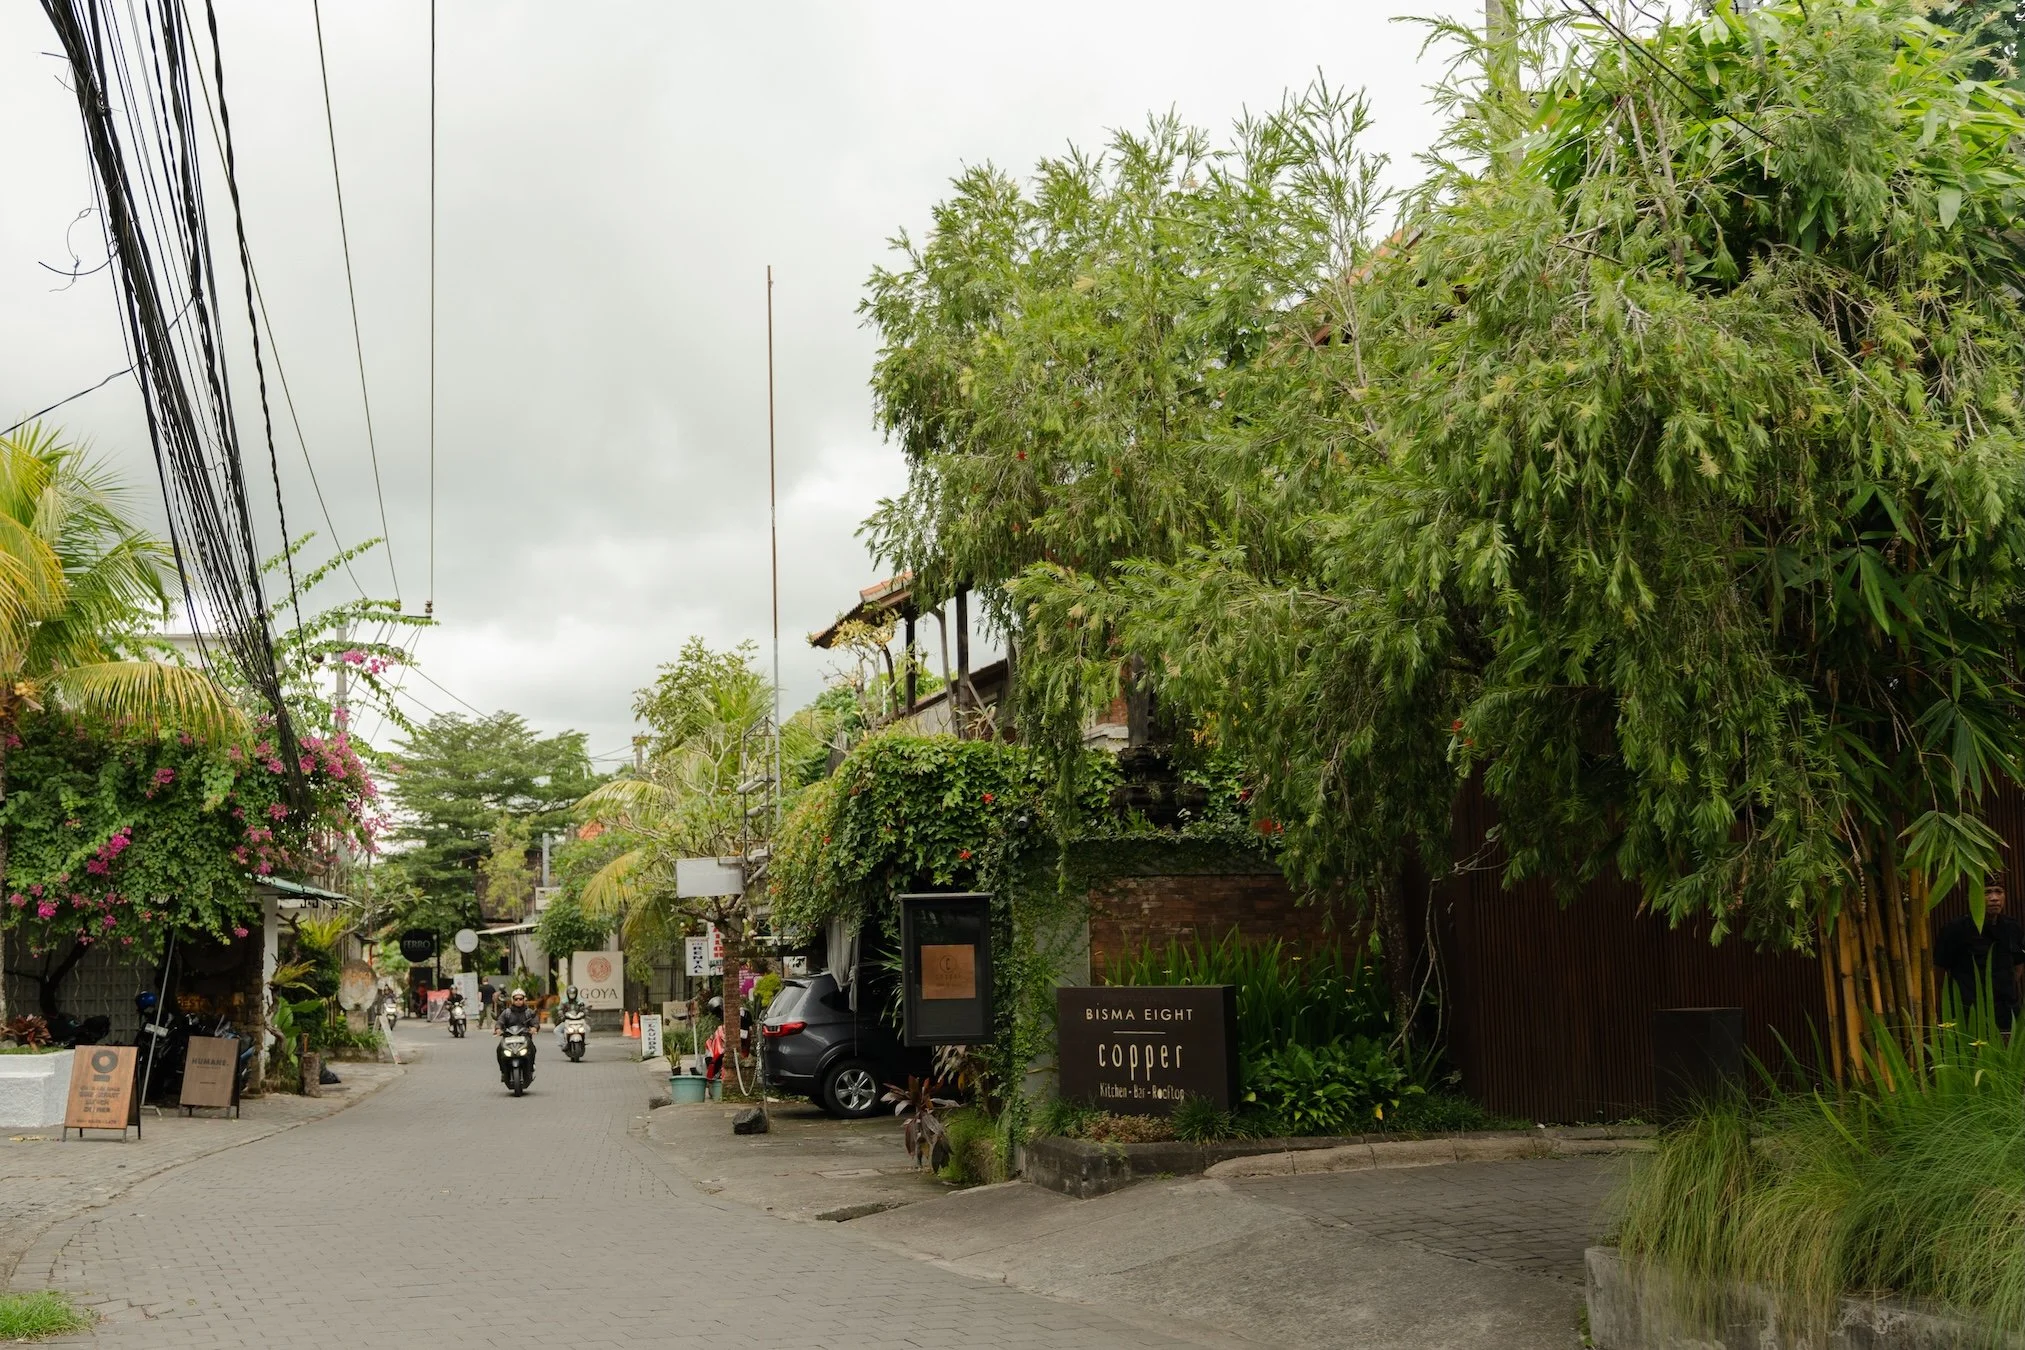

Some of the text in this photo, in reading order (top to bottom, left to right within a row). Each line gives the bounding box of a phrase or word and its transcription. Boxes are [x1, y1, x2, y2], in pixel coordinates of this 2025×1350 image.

[403, 940, 431, 950] FERRO
[693, 946, 703, 974] RENTAL
[580, 988, 618, 999] GOYA
[1085, 1008, 1193, 1020] BISMA EIGHT
[1098, 1043, 1182, 1081] copper
[1100, 1082, 1127, 1098] Kitchen
[1133, 1084, 1146, 1099] Bar
